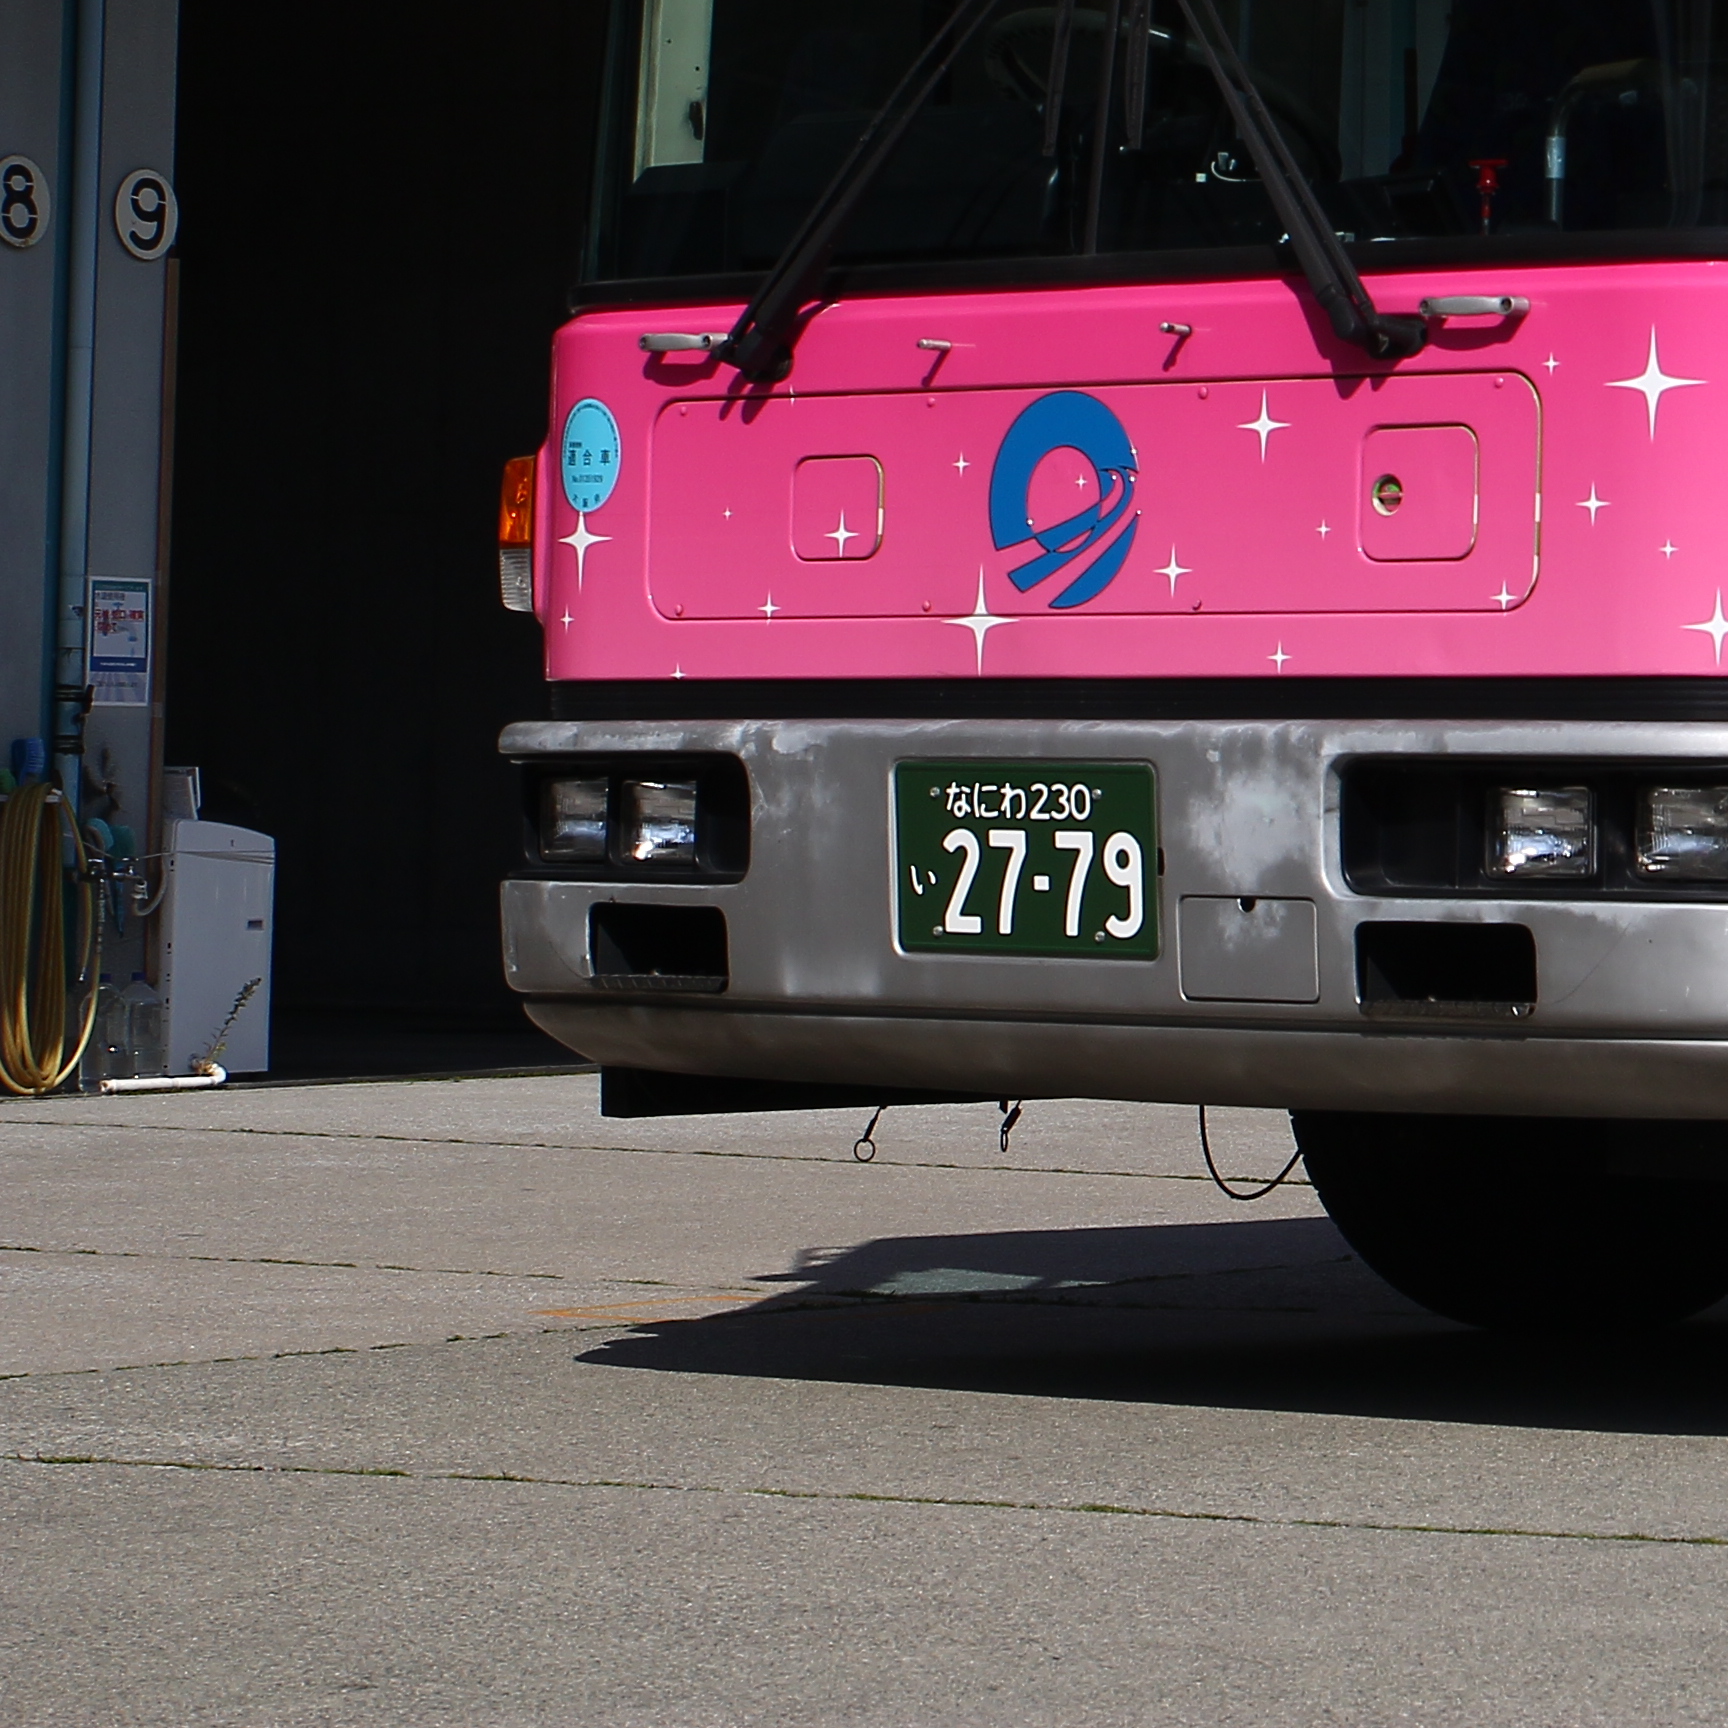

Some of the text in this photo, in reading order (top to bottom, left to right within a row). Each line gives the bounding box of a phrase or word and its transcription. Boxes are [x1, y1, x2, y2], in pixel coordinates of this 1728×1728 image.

[1, 163, 39, 240] 8
[129, 177, 167, 252] 9
[910, 865, 938, 896] い
